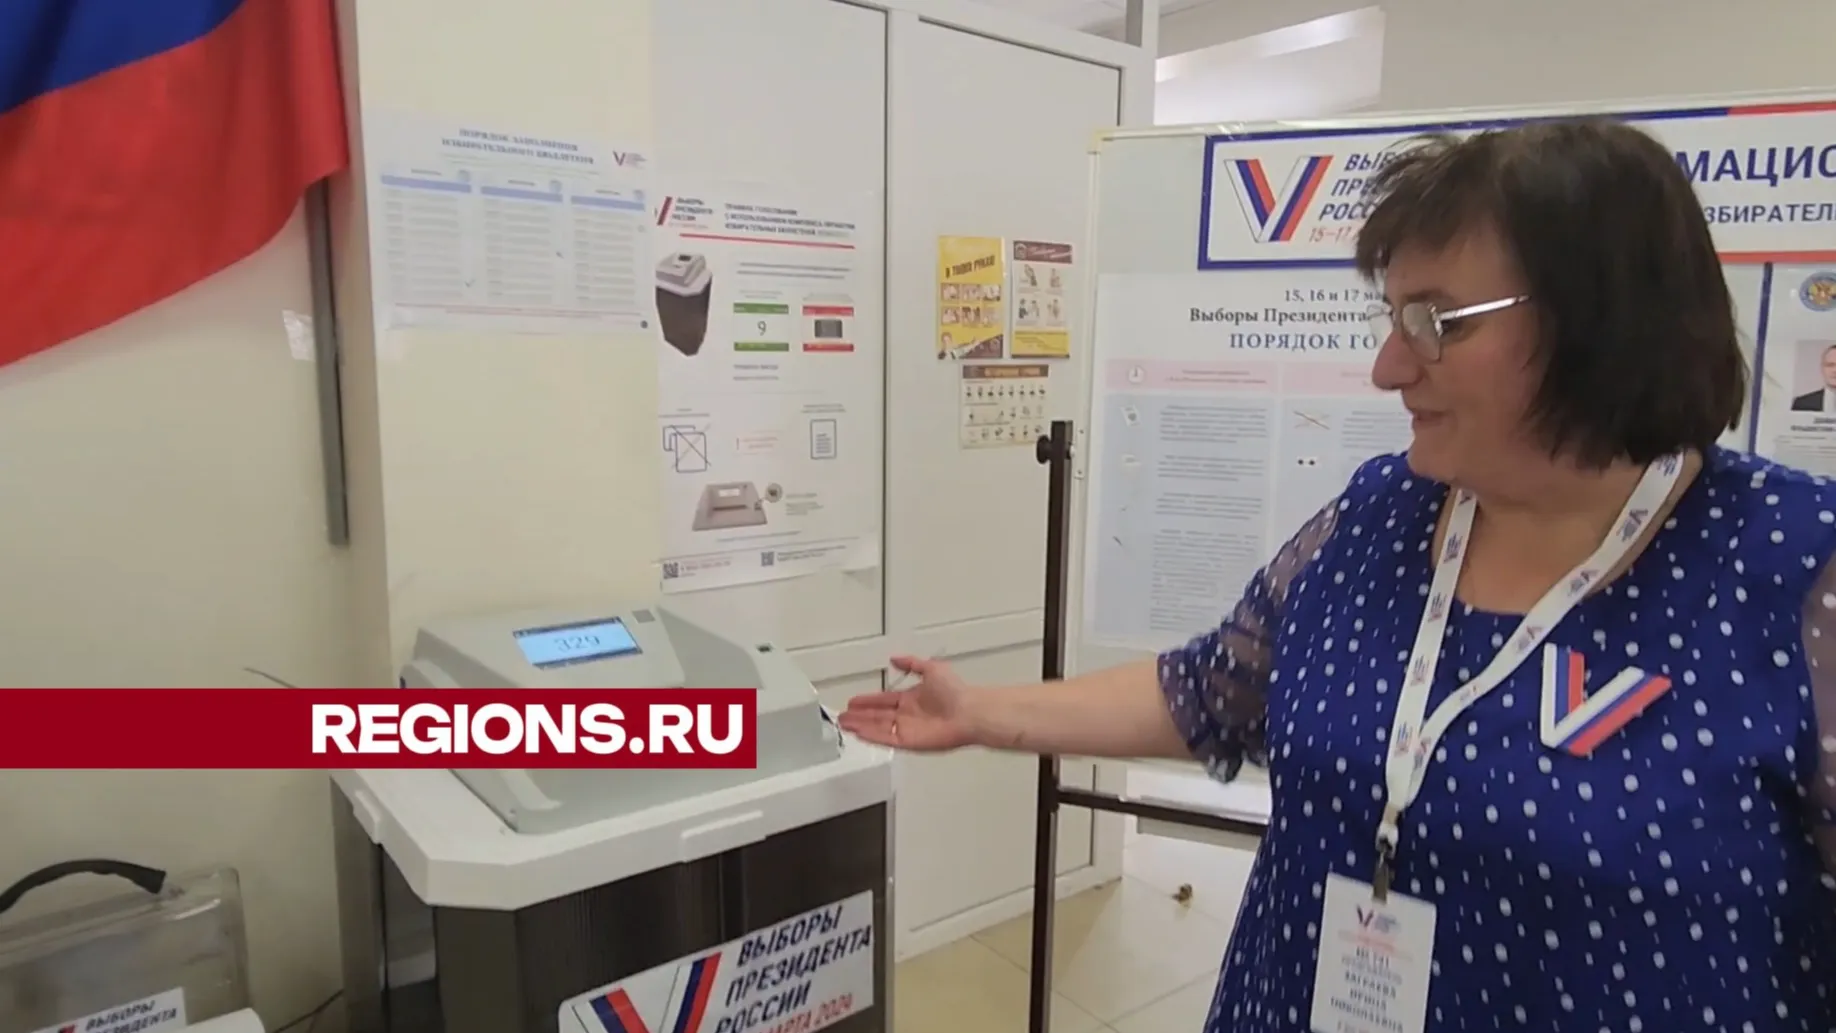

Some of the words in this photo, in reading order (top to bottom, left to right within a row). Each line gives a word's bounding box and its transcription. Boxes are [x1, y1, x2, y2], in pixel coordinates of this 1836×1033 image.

[1310, 288, 1325, 302] 16
[1344, 289, 1359, 302] 17
[1190, 308, 1258, 326] Выборы
[1264, 307, 1369, 327] Президента
[1230, 333, 1341, 351] ПОРЯДОК
[554, 635, 601, 652] 329
[737, 904, 843, 968] ВЫБОРЫ
[725, 925, 872, 1006] ПРЕЗИДЕНТА
[715, 981, 812, 1033] РОССИИ
